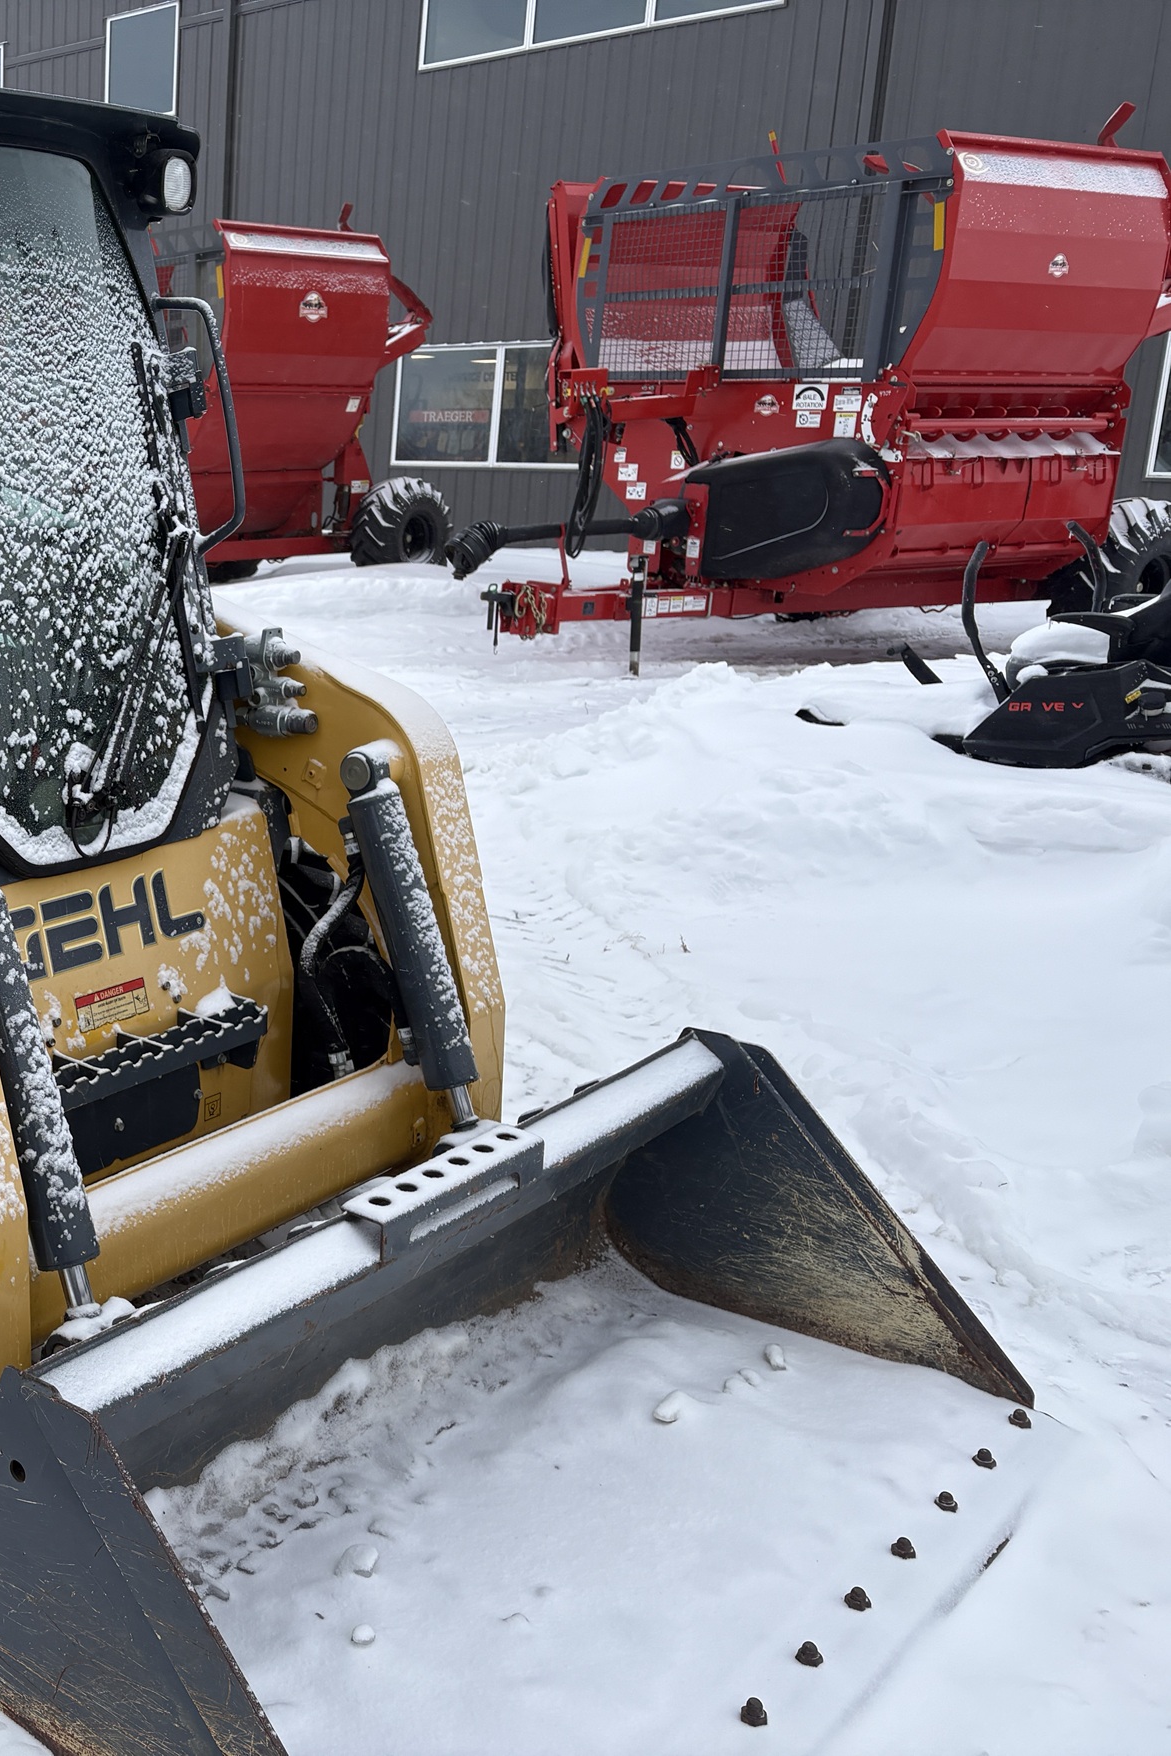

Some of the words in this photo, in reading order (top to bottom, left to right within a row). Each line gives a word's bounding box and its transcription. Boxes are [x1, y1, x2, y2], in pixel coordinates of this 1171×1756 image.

[422, 411, 473, 422] TRAEGER
[9, 868, 206, 982] GEHL
[99, 986, 124, 1000] DANGER
